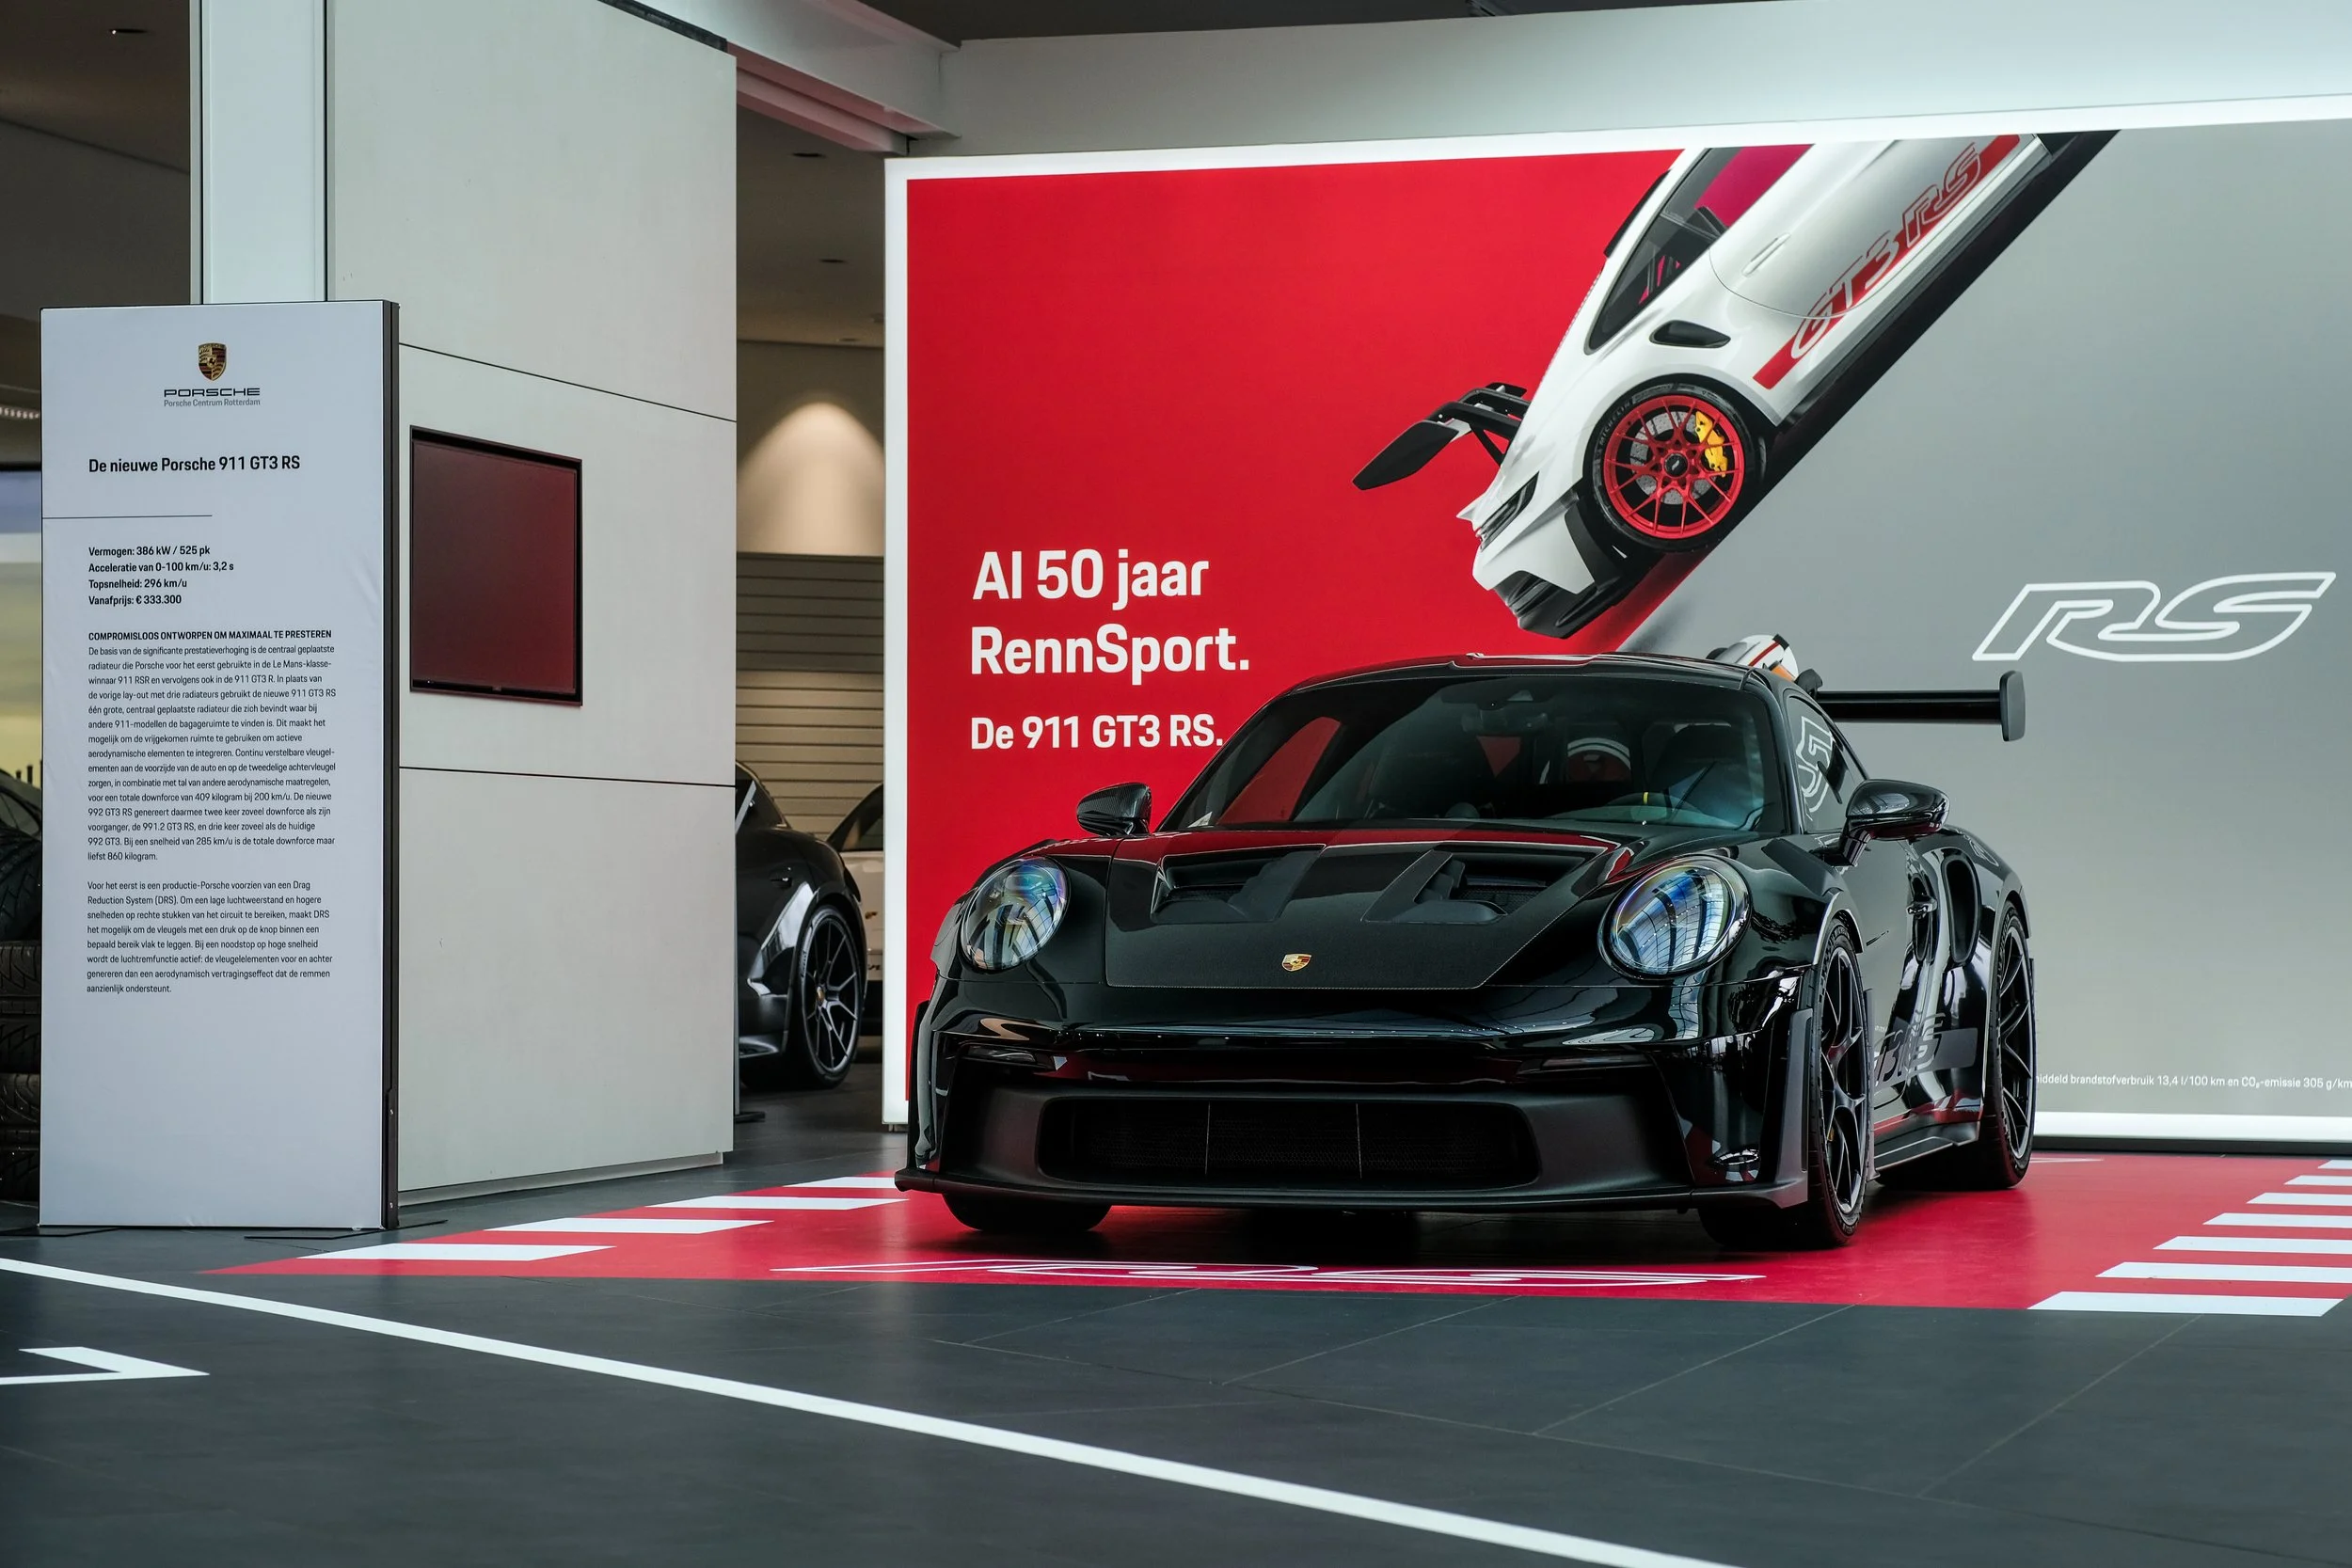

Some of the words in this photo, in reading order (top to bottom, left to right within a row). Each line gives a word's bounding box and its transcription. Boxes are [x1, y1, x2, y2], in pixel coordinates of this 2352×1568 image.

[1790, 230, 1900, 359] GT3
[1902, 141, 1982, 248] RS
[163, 388, 261, 397] PORSCHE
[164, 399, 192, 407] Porsche
[224, 398, 261, 406] Rotterdam
[88, 458, 106, 472] De
[110, 457, 158, 472] nieuwe
[161, 456, 215, 471] Porsche
[218, 455, 244, 470] 911
[249, 454, 278, 469] GT3
[281, 454, 299, 469] RS
[88, 546, 135, 559] Vermogen:
[135, 546, 154, 556] 386
[155, 546, 170, 555] kW
[172, 545, 177, 555] /
[179, 545, 198, 555] 525
[199, 545, 210, 557] pk
[88, 562, 136, 572] Acceleratie
[137, 563, 153, 572] van
[154, 562, 183, 571] 0-100
[184, 561, 211, 571] km/u:
[213, 561, 227, 572] 3,2
[89, 578, 142, 591] Topsnelheid:
[144, 578, 162, 588] 296
[163, 578, 186, 588] km/u
[972, 550, 1023, 600] Al
[1037, 548, 1104, 599] 50
[1112, 548, 1210, 610] jaar
[88, 594, 134, 608] Vanafprijs:
[135, 594, 142, 604] €
[143, 594, 182, 605] 333.300
[1972, 571, 2336, 662] RS
[88, 631, 159, 641] COMPROMISLOOS
[160, 630, 213, 640] ONTWORPEN
[214, 630, 227, 640] OM
[228, 630, 273, 639] MAXIMAAL
[273, 630, 283, 639] TE
[284, 629, 331, 639] PRESTEREN
[88, 646, 98, 656] De
[99, 646, 118, 656] basis
[132, 646, 141, 655] de
[142, 645, 183, 657] significante
[183, 644, 248, 657] prestatieverhoging
[250, 644, 256, 654] is
[257, 644, 266, 654] de
[267, 644, 296, 654] centraal
[297, 644, 334, 656] geplaatste
[971, 623, 1249, 686] RennSport.
[87, 690, 97, 700] de
[98, 689, 121, 702] vorige
[122, 689, 150, 702] lay-out
[149, 689, 165, 699] met
[166, 689, 181, 699] drie
[182, 689, 218, 699] radiateurs
[219, 689, 251, 700] gebruikt
[251, 689, 262, 699] de
[262, 689, 289, 698] nieuwe
[291, 689, 306, 698] 911
[308, 688, 324, 698] GT3
[326, 688, 336, 697] RS
[87, 719, 114, 729] andere
[115, 719, 167, 729] 911-modellen
[167, 719, 178, 729] de
[179, 719, 230, 730] bagageruimte
[230, 720, 239, 729] te
[240, 718, 264, 729] vinden
[276, 718, 287, 728] Dit
[288, 718, 311, 727] maakt
[313, 718, 325, 727] het
[971, 717, 1014, 750] De
[1022, 715, 1079, 749] 911
[1092, 714, 1161, 748] GT3
[1169, 713, 1223, 747] RS.
[87, 749, 146, 760] aerodynamische
[147, 748, 184, 758] elementen
[186, 749, 194, 757] te
[195, 748, 233, 759] integreren.
[234, 748, 263, 757] Continu
[264, 748, 304, 757] verstelbare
[305, 747, 336, 758] vleugel-
[87, 780, 113, 789] zorgen,
[114, 779, 120, 788] in
[121, 778, 161, 788] combinatie
[162, 779, 177, 788] met
[178, 778, 186, 788] tal
[201, 778, 226, 787] andere
[227, 778, 284, 789] aerodynamische
[285, 777, 330, 789] maatregelen,
[87, 807, 103, 816] 992
[104, 807, 120, 817] GT3
[120, 807, 133, 817] RS
[134, 808, 169, 818] genereert
[170, 807, 202, 816] daarmee
[204, 808, 223, 816] twee
[224, 807, 240, 816] keer
[241, 806, 264, 816] zoveel
[265, 806, 305, 816] downforce
[306, 806, 316, 816] als
[318, 806, 330, 817] zijn
[87, 851, 106, 861] liefst
[106, 851, 123, 861] 860
[124, 851, 158, 863] kilogram.
[87, 880, 104, 890] Voor
[105, 880, 119, 890] het
[119, 881, 137, 890] eerst
[139, 880, 146, 890] is
[162, 880, 230, 892] productie-Porsche
[230, 880, 262, 890] voorzien
[293, 880, 310, 892] Drag
[87, 910, 124, 920] snelheden
[125, 911, 135, 921] op
[136, 910, 160, 920] rechte
[161, 910, 190, 920] stukken
[191, 911, 204, 920] van
[206, 910, 218, 920] het
[219, 910, 243, 919] circuit
[245, 911, 252, 919] te
[253, 910, 288, 920] bereiken,
[288, 910, 312, 919] maakt
[313, 910, 329, 919] DRS
[87, 954, 109, 964] wordt
[108, 954, 119, 964] de
[120, 954, 179, 964] luchtremfunctie
[180, 954, 202, 964] actief:
[204, 954, 214, 964] de
[215, 954, 279, 965] vleugelelementen
[309, 954, 331, 963] achter
[87, 983, 124, 994] aanzienlijk
[125, 983, 173, 993] ondersteunt.
[2071, 1073, 2154, 1085] brandstofverbruik
[2157, 1075, 2178, 1086] 13,4
[2211, 1076, 2225, 1086] km
[2228, 1078, 2239, 1087] en
[2304, 1077, 2324, 1088] 305
